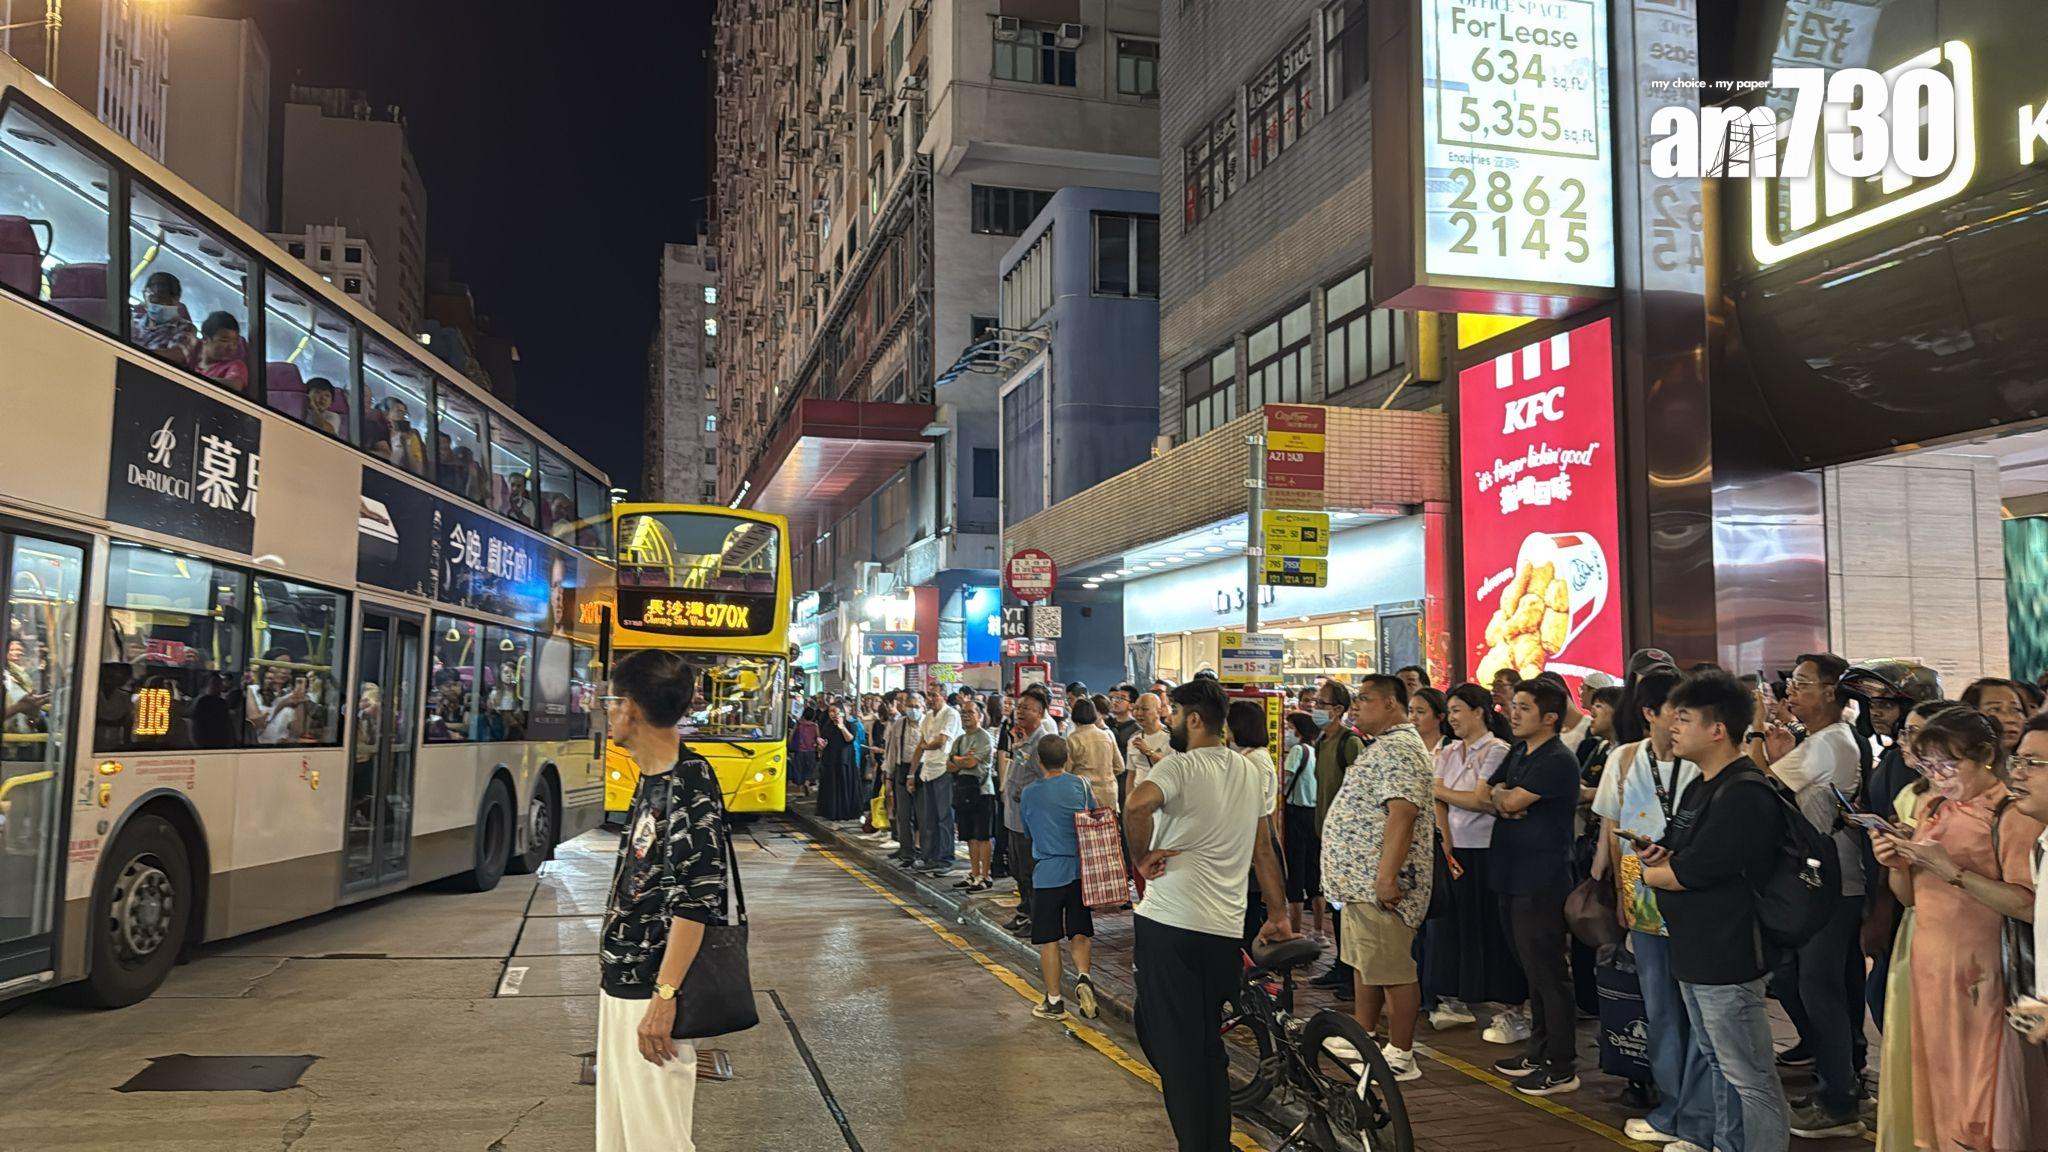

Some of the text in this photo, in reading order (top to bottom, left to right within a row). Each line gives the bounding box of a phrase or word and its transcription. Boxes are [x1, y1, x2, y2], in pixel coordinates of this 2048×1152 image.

[1519, 2, 1567, 19] SPACE
[1452, 7, 1578, 49] For Lease
[1472, 47, 1546, 89] 634
[1459, 97, 1561, 141] 5,355
[1448, 152, 1490, 167] Enquiries
[1448, 167, 1587, 220] 2862
[1448, 211, 1590, 264] 2145
[1502, 386, 1565, 435] KFC
[1269, 452, 1285, 461] A21
[1493, 458, 1528, 483] finger
[128, 464, 191, 501] DeRUCCI
[706, 604, 749, 629] 970X
[1002, 622, 1025, 636] 146
[1003, 608, 1024, 621] YT
[1244, 661, 1256, 672] 15
[135, 688, 171, 735] 118
